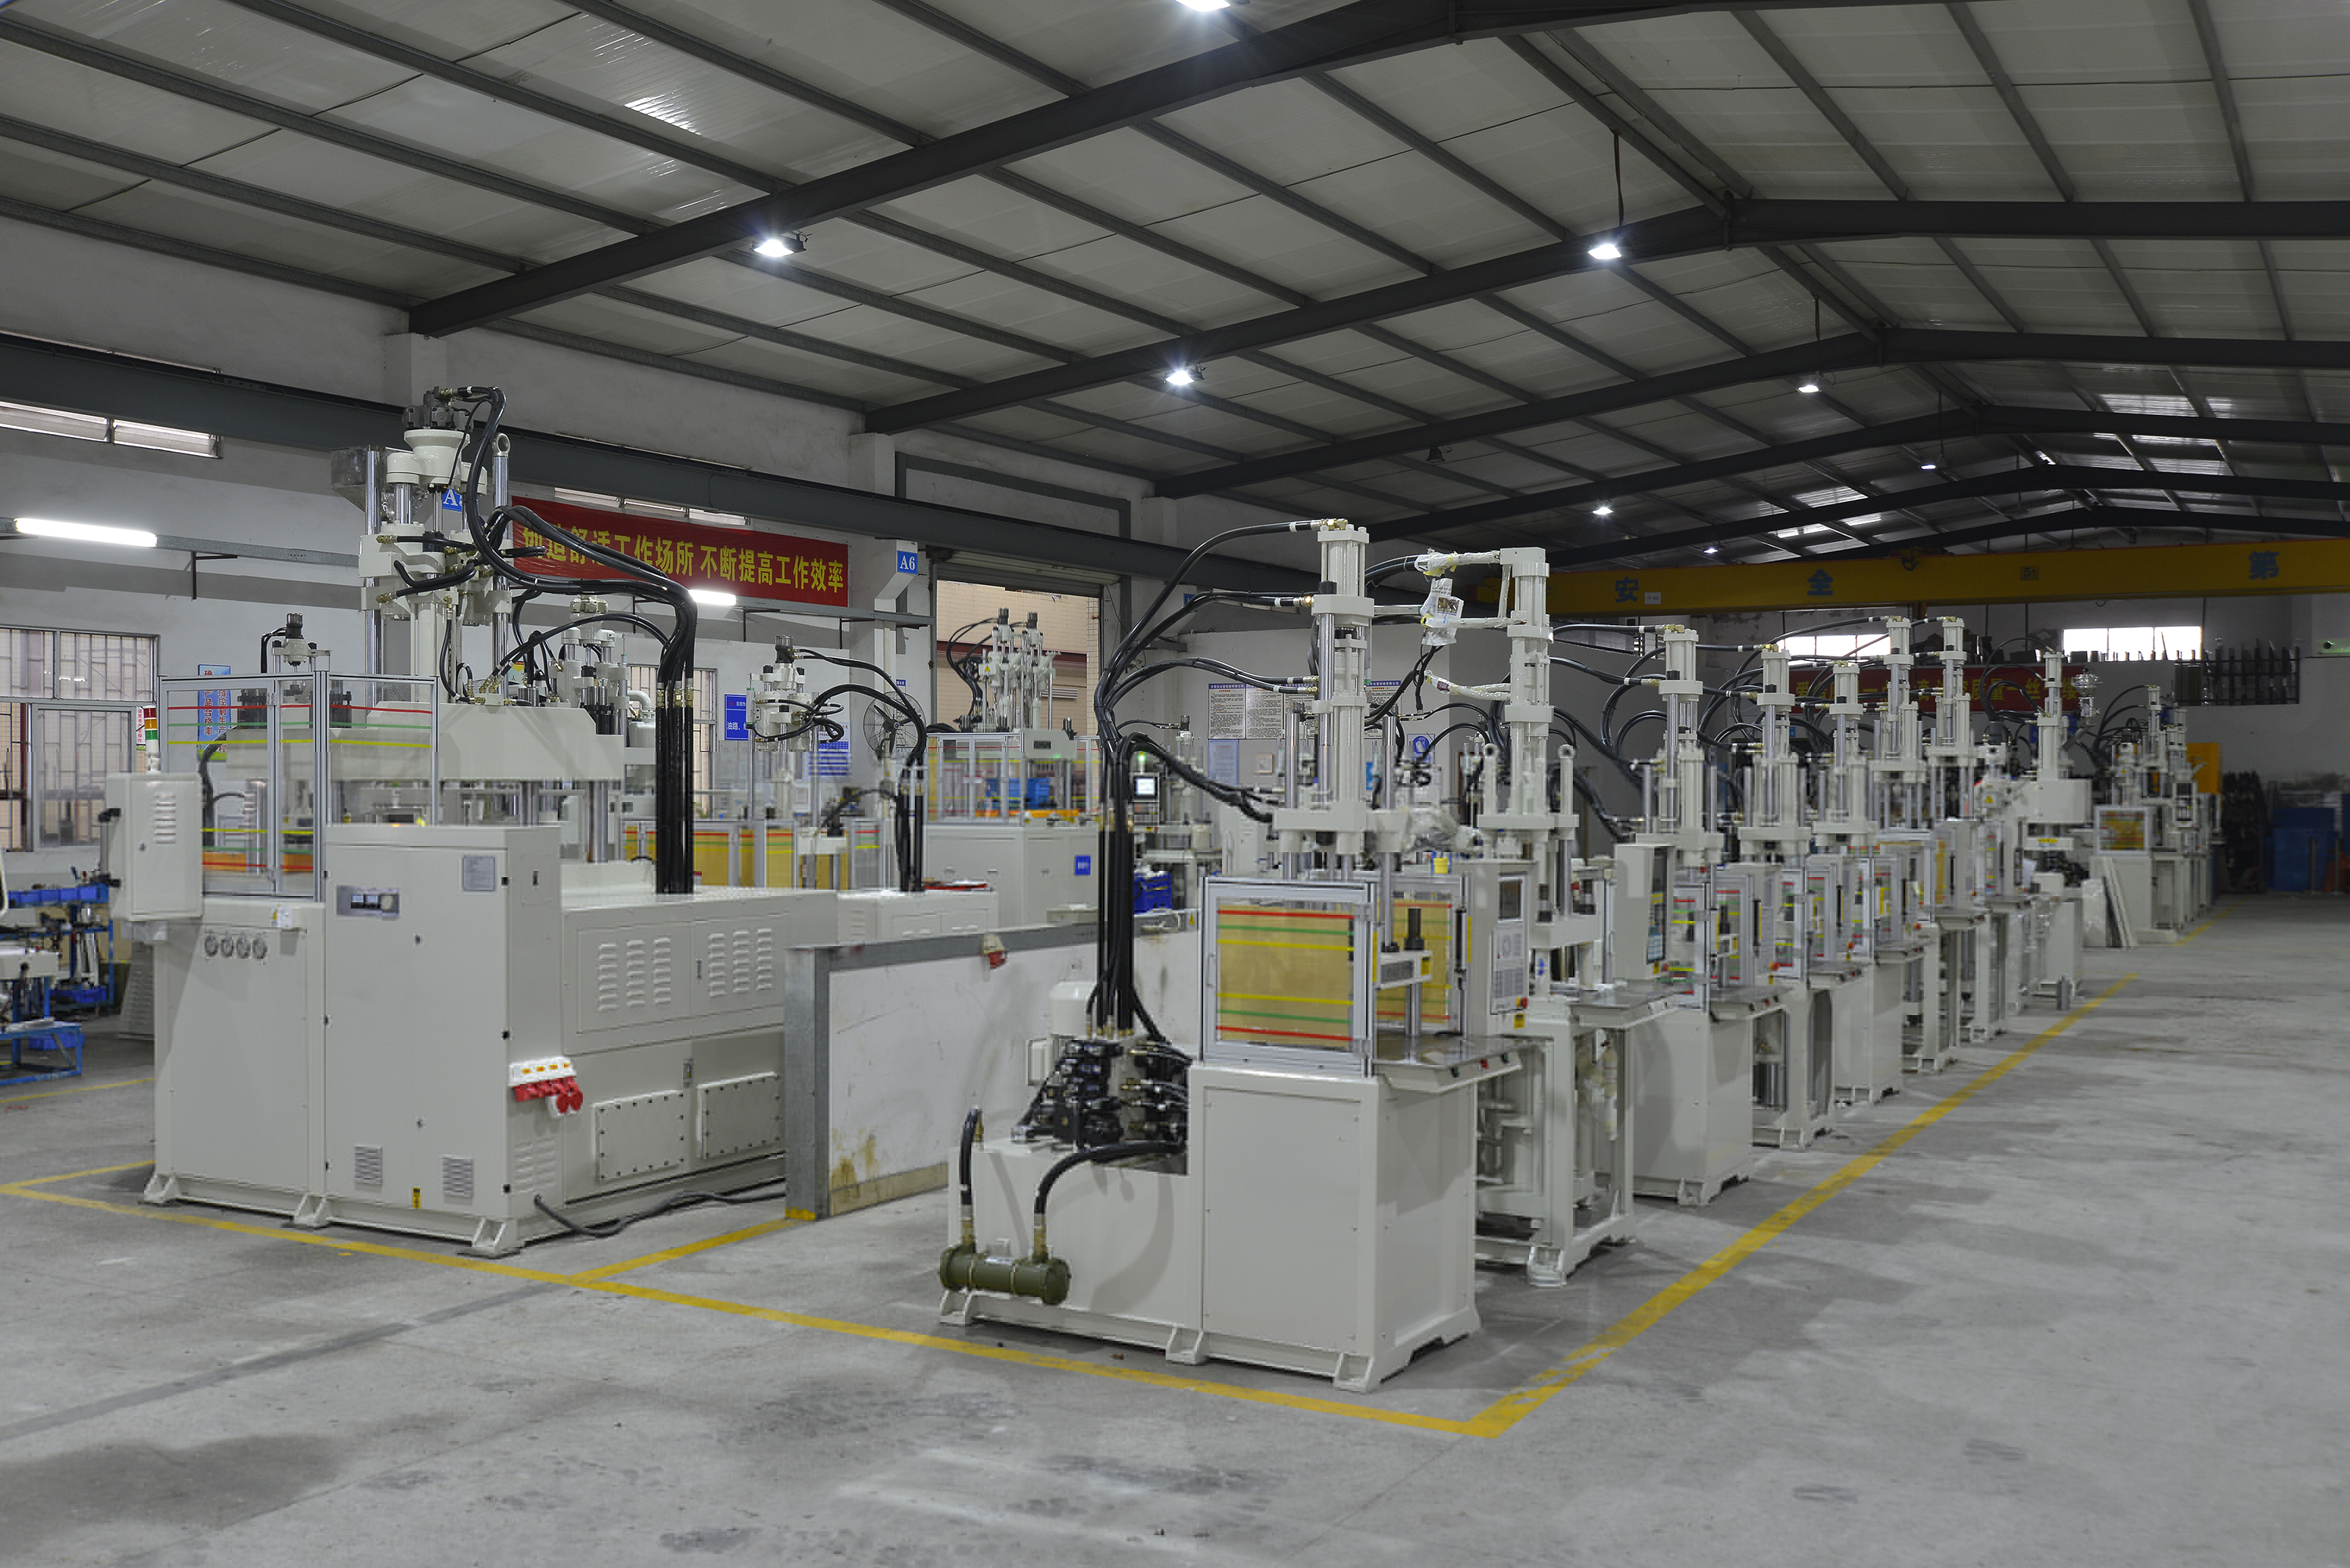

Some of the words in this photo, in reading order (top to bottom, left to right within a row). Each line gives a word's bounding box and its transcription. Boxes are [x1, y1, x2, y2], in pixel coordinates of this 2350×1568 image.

[443, 489, 462, 507] A
[700, 545, 844, 593] 不断提高工作效率
[900, 555, 916, 571] A6
[1614, 576, 1640, 603] 安
[1806, 569, 1834, 596] 全
[2247, 551, 2280, 580] 第
